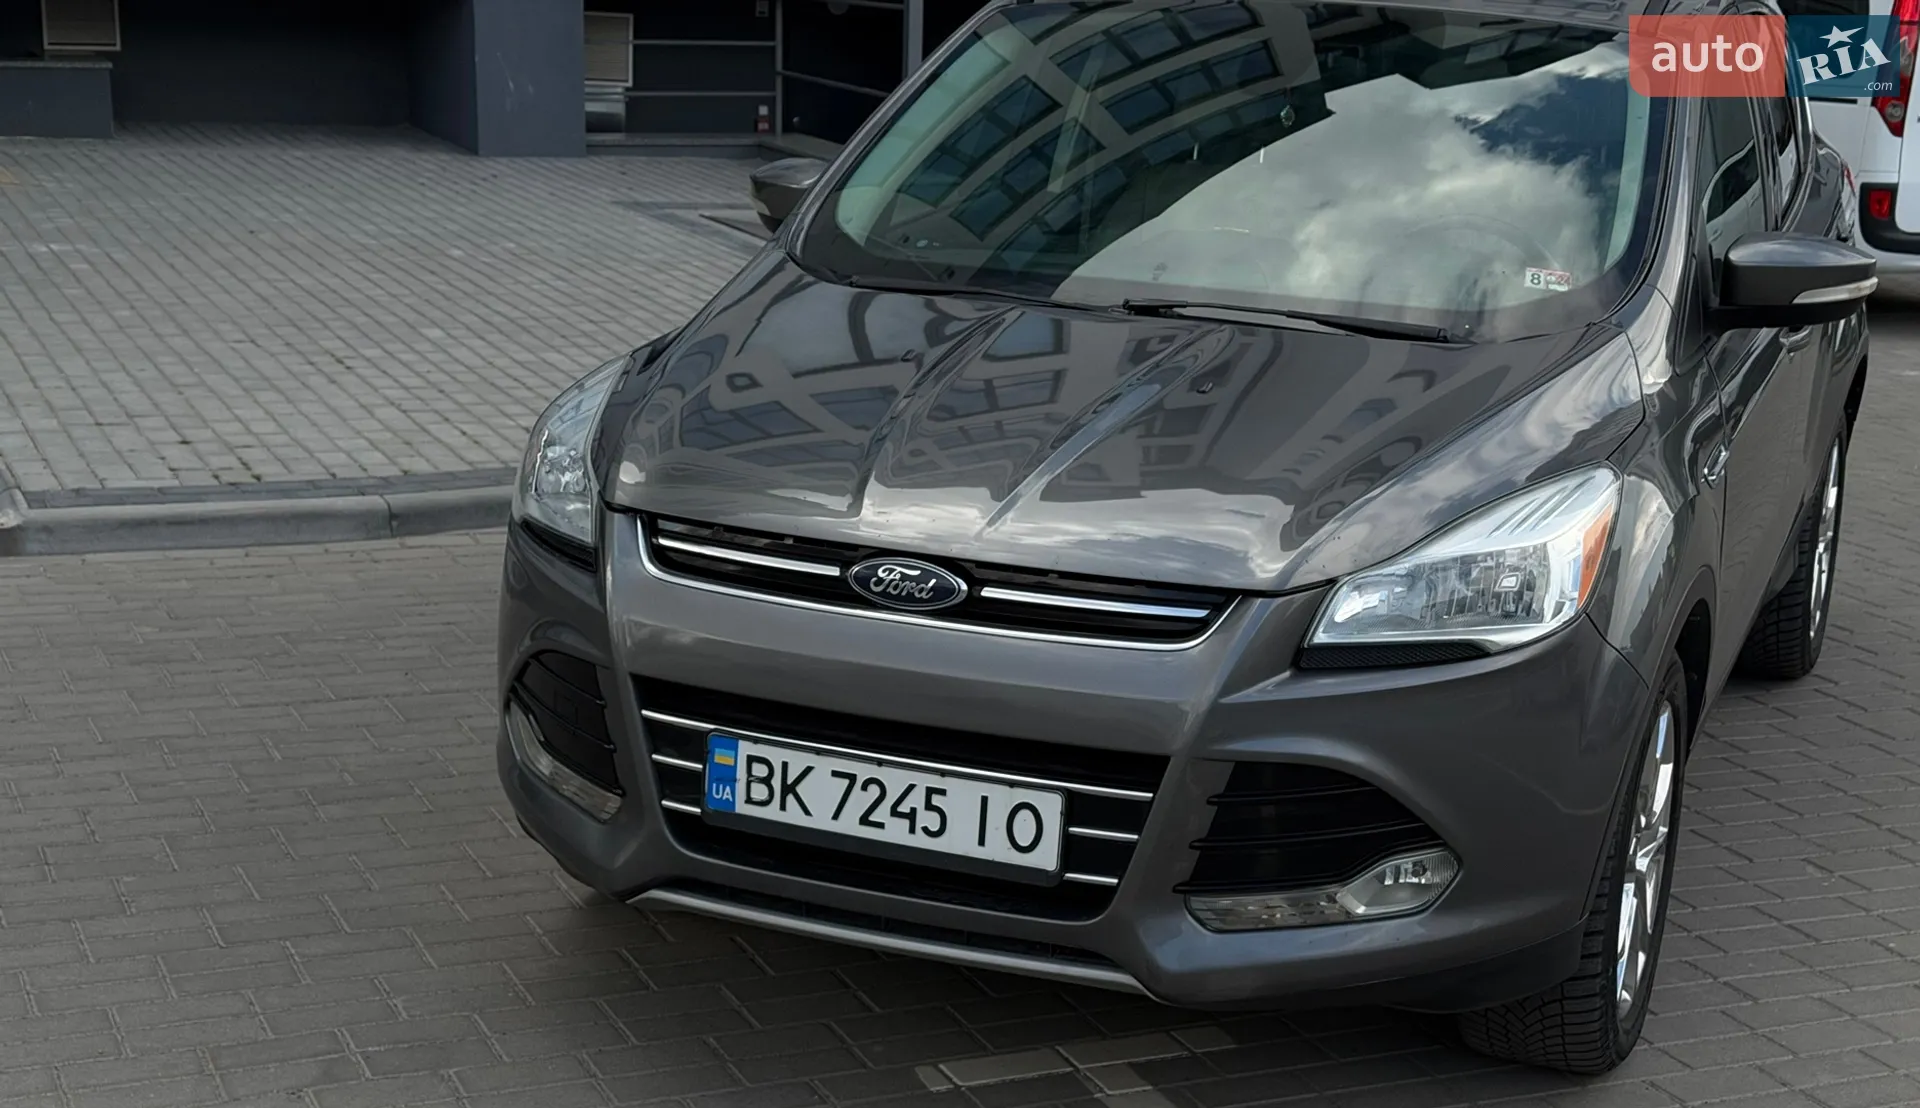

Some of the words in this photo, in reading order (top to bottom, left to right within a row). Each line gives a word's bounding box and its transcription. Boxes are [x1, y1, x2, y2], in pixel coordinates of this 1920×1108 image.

[1530, 272, 1541, 286] 8
[870, 565, 937, 599] Ford
[712, 783, 733, 802] UA
[744, 754, 815, 817] BK
[830, 770, 948, 838] 7245
[977, 794, 1044, 853] IO
